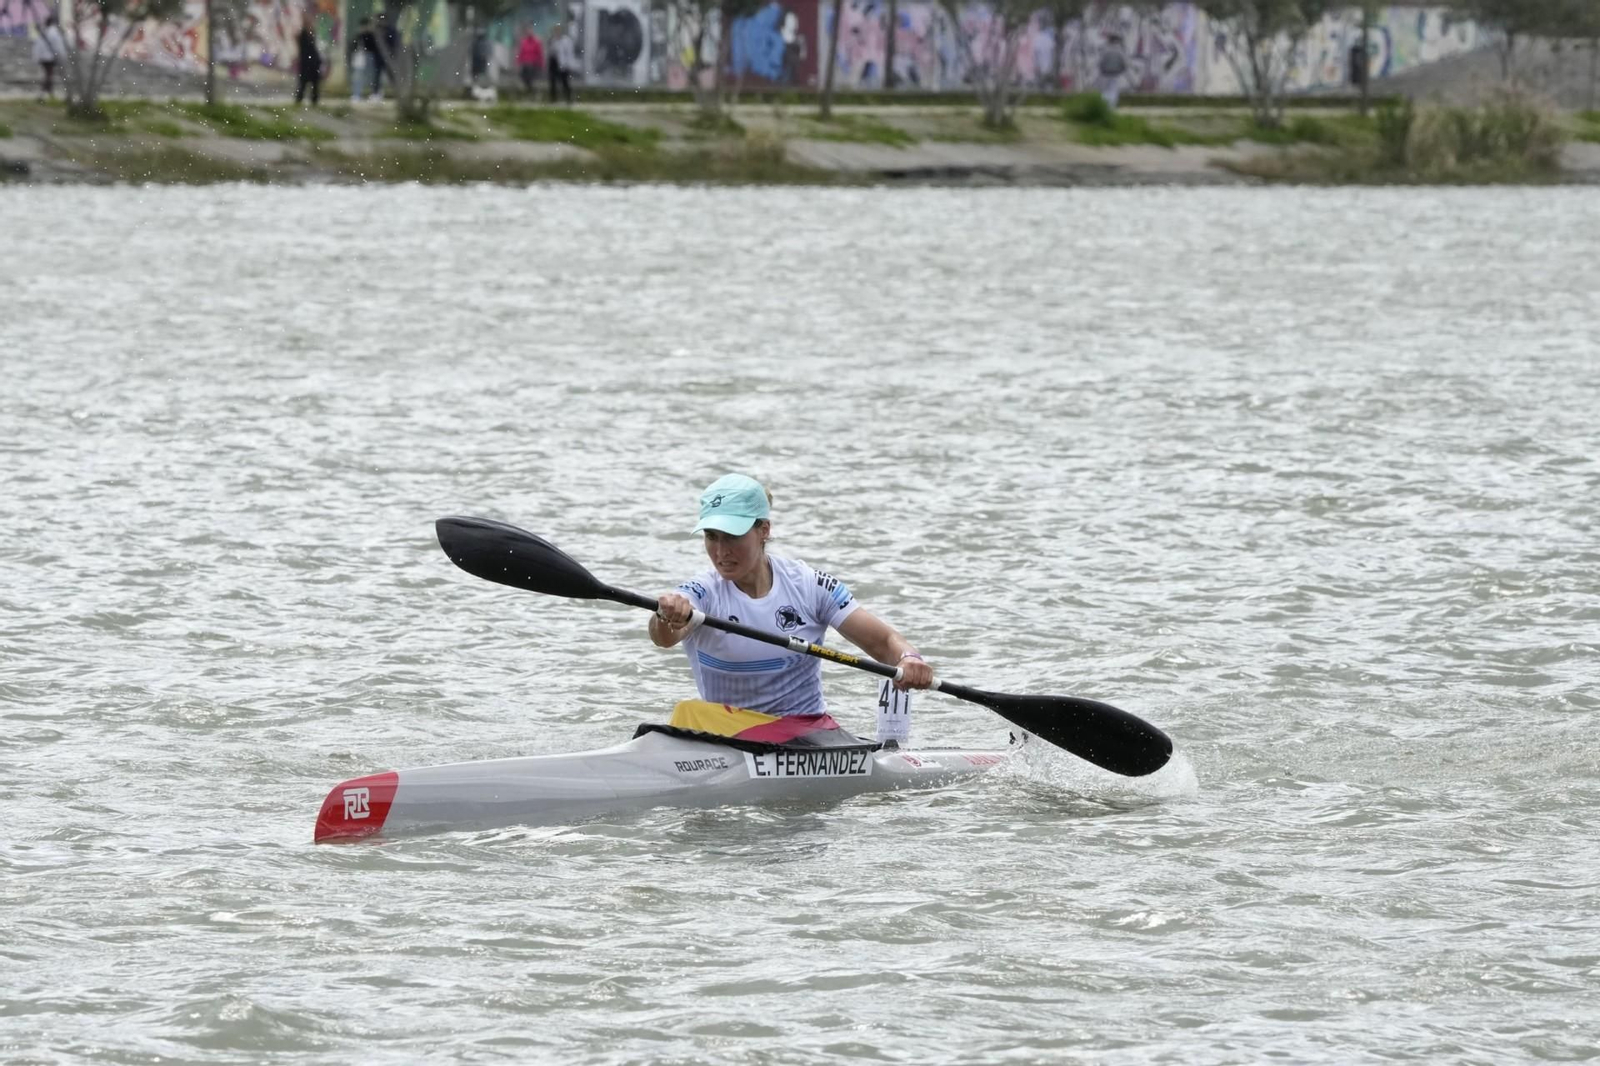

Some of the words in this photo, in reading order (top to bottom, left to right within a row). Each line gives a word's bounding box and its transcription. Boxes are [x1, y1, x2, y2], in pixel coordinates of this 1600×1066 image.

[674, 757, 728, 772] ROURACE
[753, 752, 771, 776] E.
[776, 750, 868, 776] FERNANDEZ
